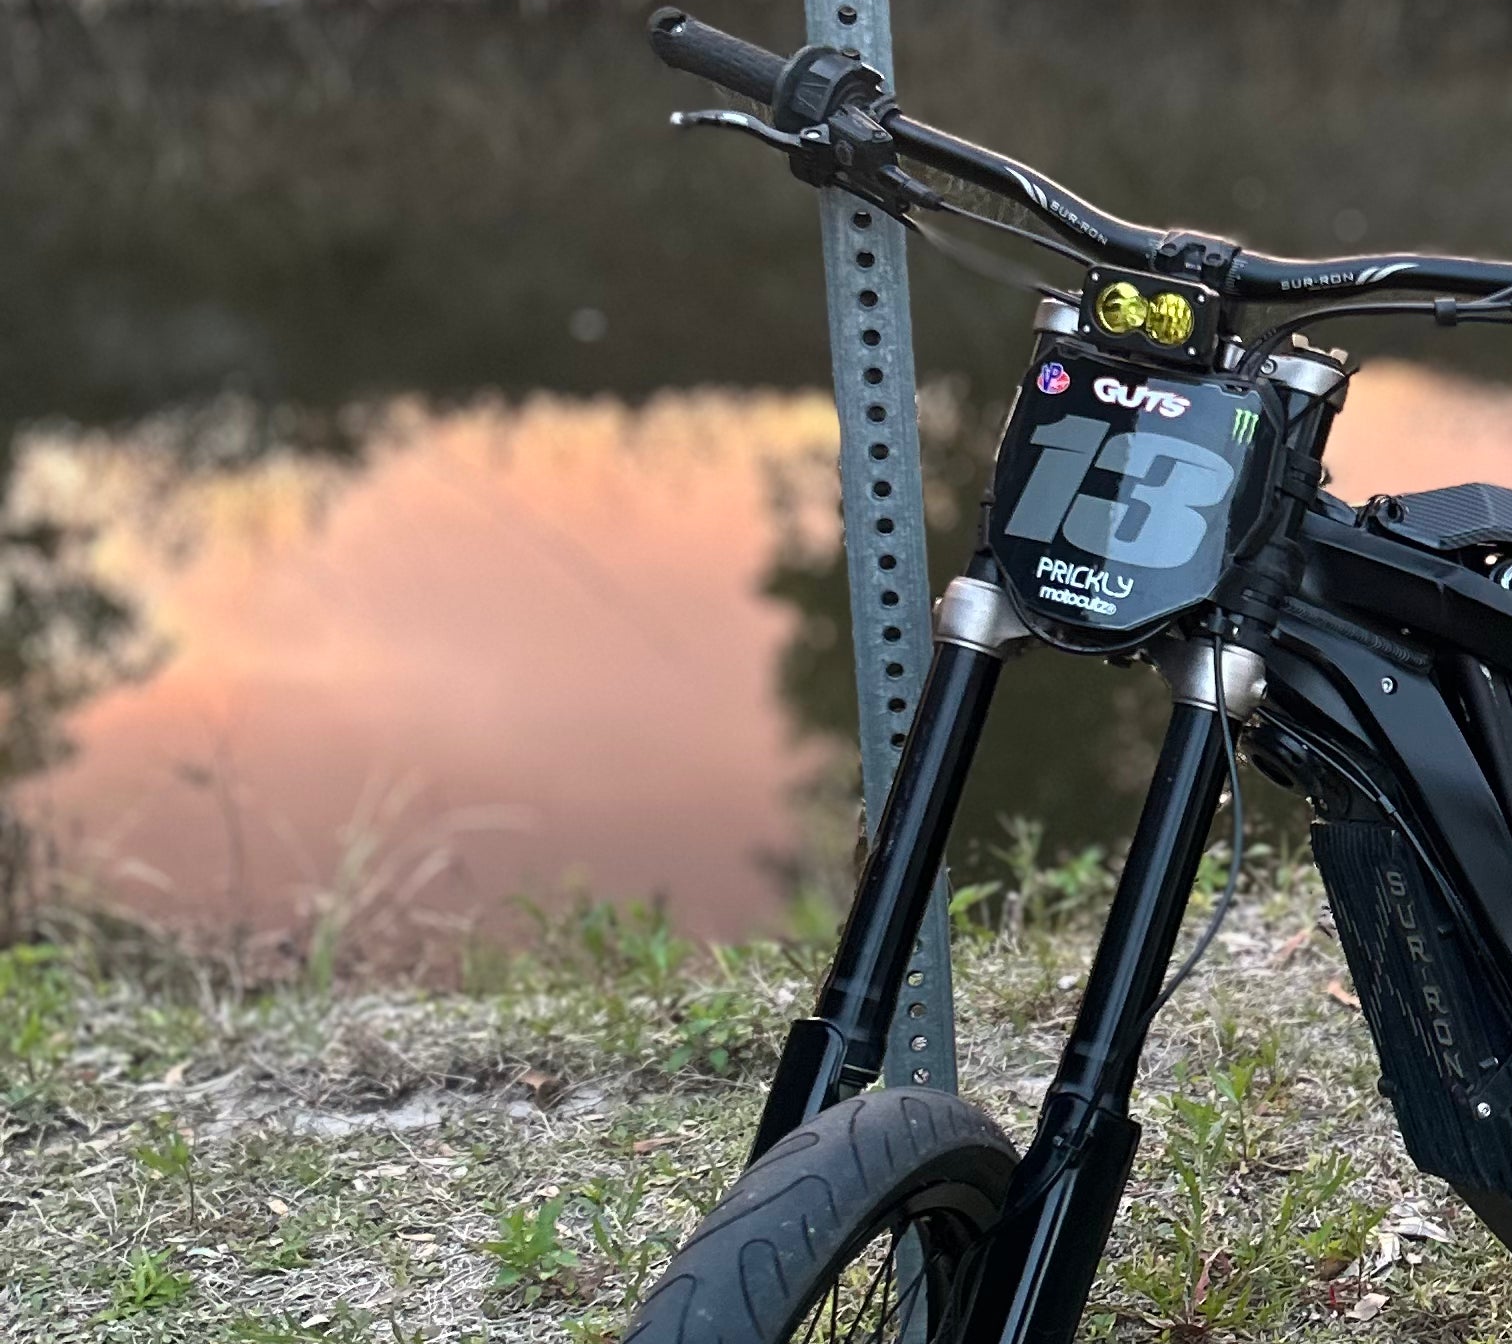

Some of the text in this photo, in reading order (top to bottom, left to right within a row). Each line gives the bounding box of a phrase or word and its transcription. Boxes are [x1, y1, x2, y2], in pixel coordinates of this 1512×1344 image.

[1050, 200, 1108, 246] SUR-RON
[1280, 272, 1354, 291] SUR-RON
[1093, 376, 1191, 418] GUTS
[1004, 414, 1235, 569] 13
[1036, 556, 1134, 598] PRICKLY
[1386, 870, 1465, 1080] SUR-RON
